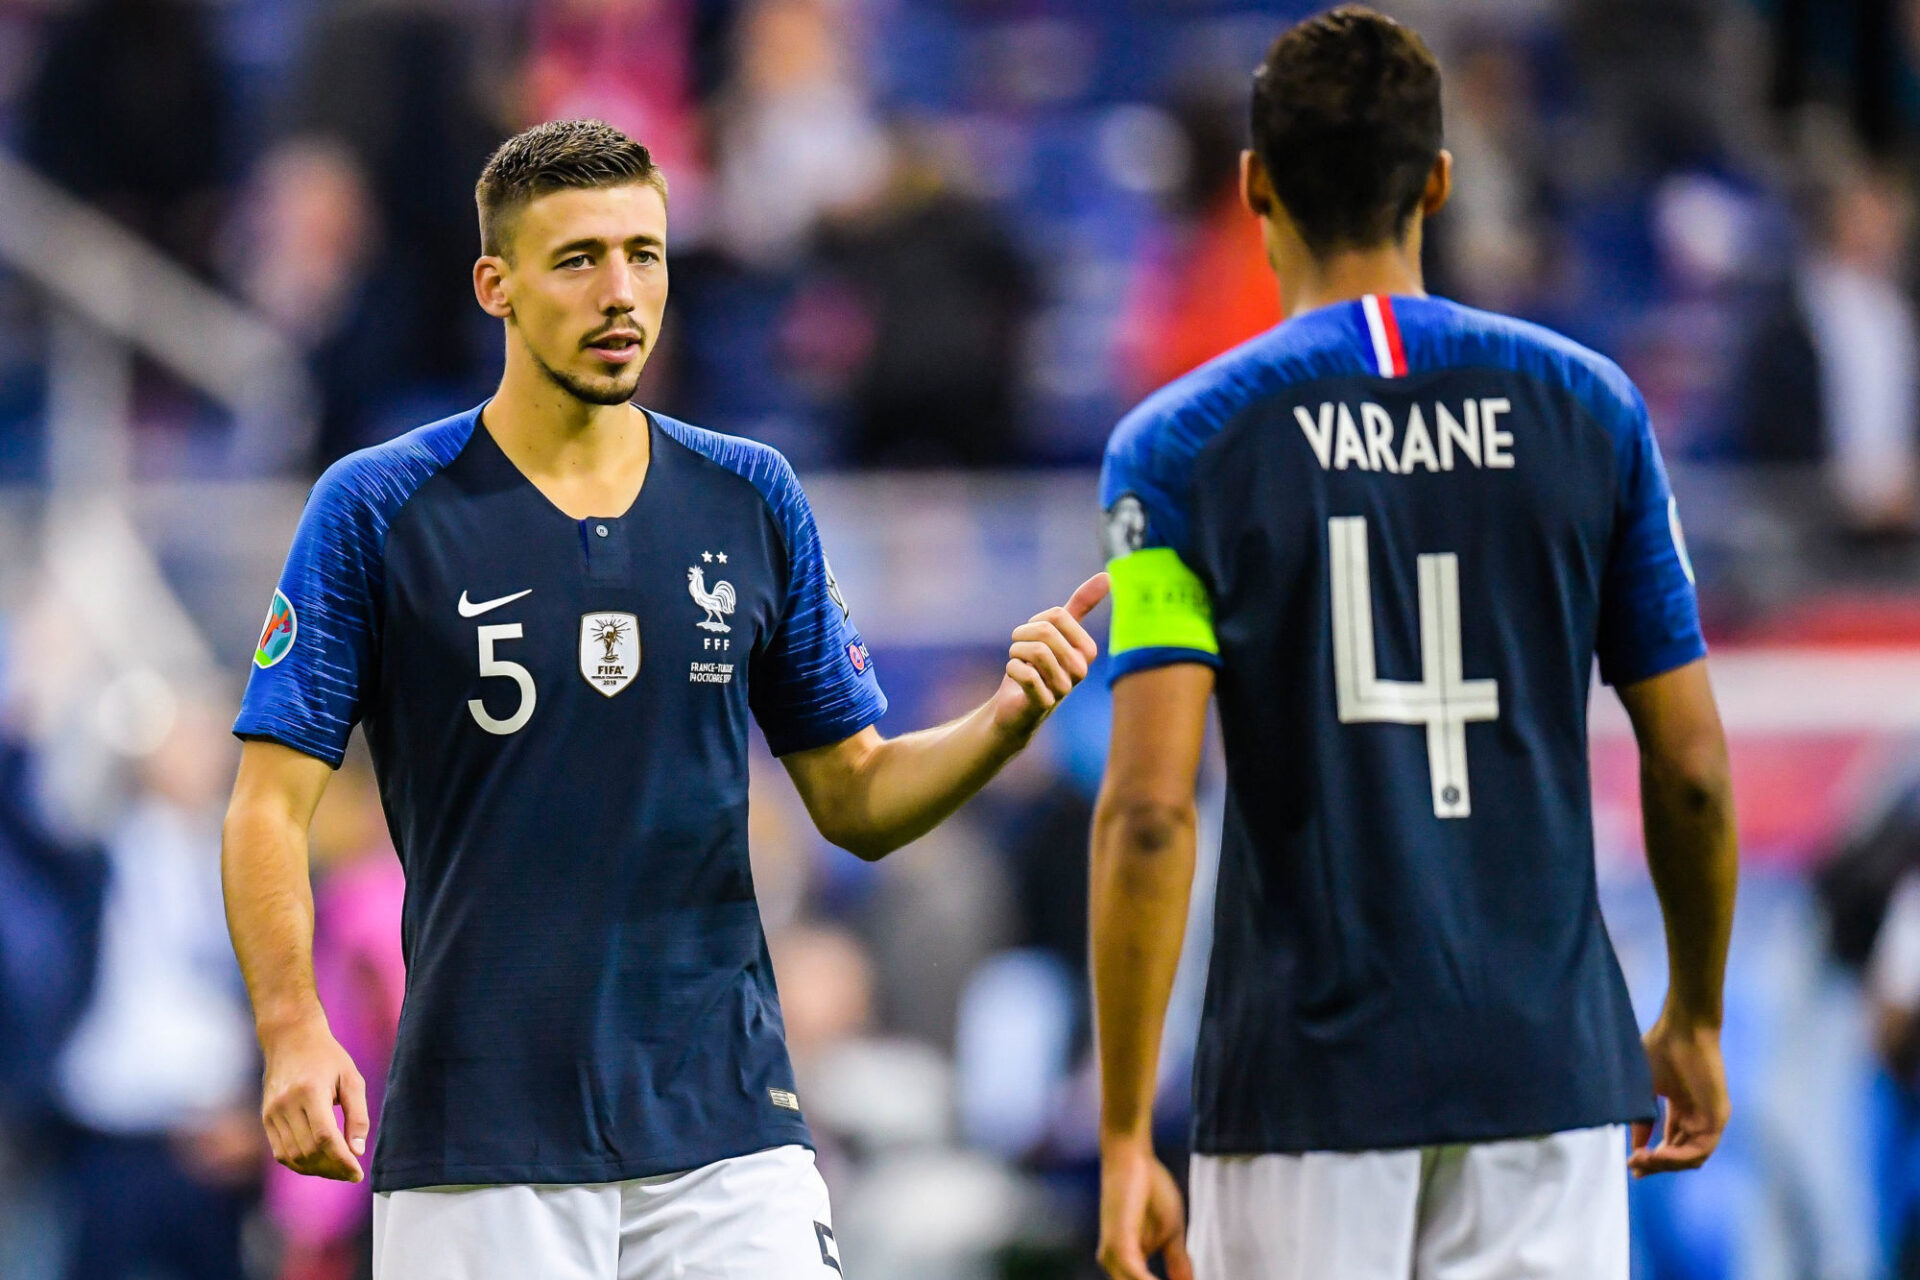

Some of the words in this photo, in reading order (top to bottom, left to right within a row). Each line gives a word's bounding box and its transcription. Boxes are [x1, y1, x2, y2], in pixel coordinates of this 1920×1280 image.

[1293, 398, 1515, 474] VARANE
[467, 622, 537, 735] 5
[597, 665, 622, 675] FIFA
[1328, 516, 1499, 819] 4
